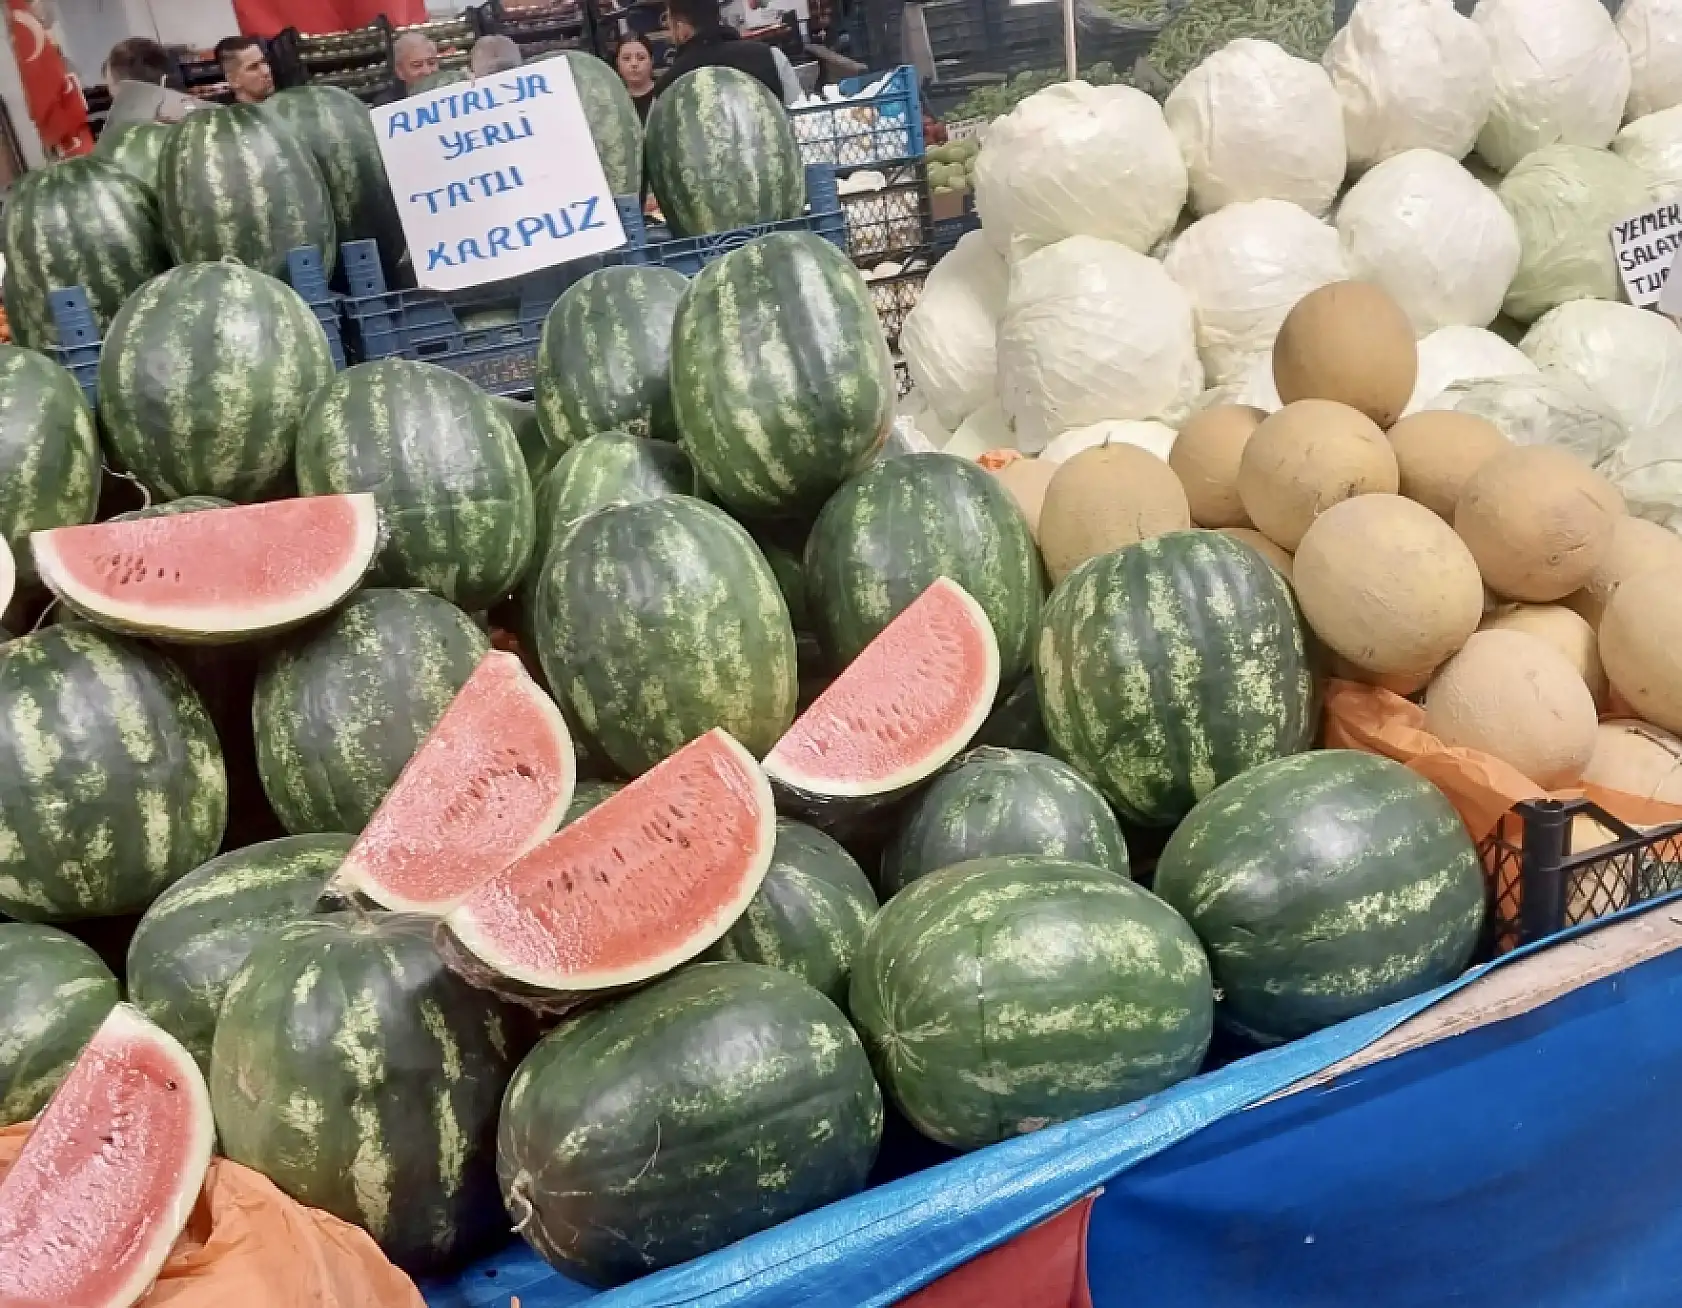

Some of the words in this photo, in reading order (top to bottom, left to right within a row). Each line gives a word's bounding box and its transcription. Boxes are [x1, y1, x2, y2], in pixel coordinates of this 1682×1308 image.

[389, 74, 553, 138] ANTALYA
[438, 110, 535, 160] YERLİ
[410, 166, 524, 214] TATLI
[426, 196, 606, 271] KARPUZ
